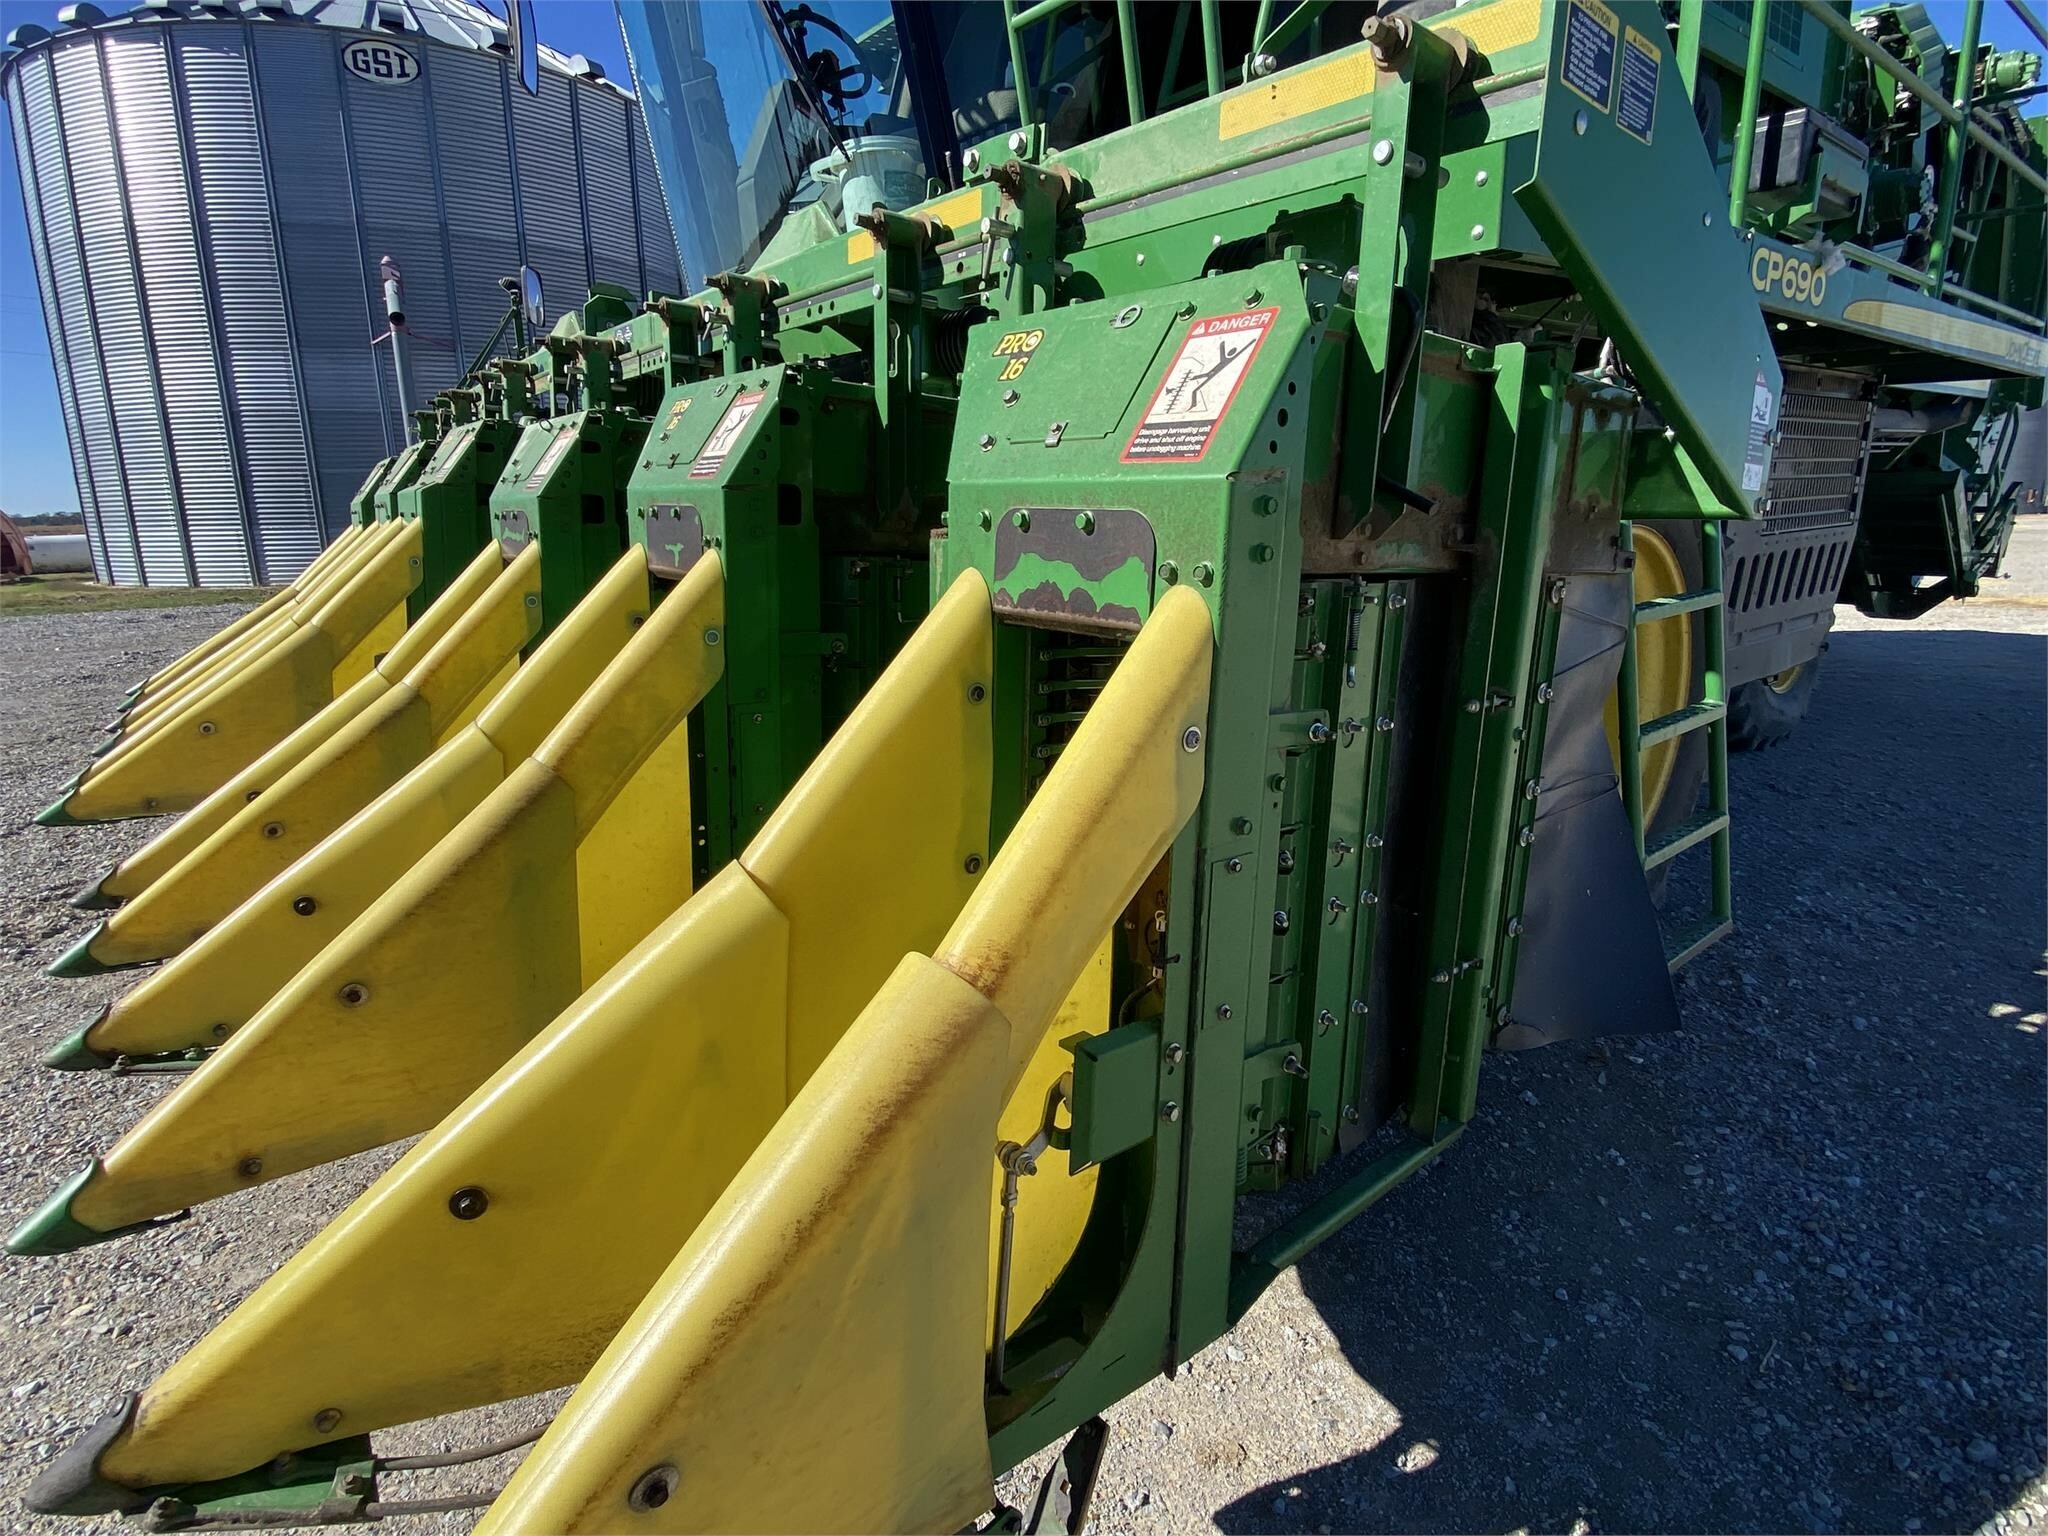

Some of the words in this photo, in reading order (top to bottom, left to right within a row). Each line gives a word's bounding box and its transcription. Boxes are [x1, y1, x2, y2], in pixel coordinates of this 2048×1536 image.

[351, 47, 410, 78] GSI
[1751, 247, 1827, 306] CP690
[1207, 312, 1272, 333] DANGER
[993, 330, 1044, 356] PRO
[999, 357, 1030, 380] 16
